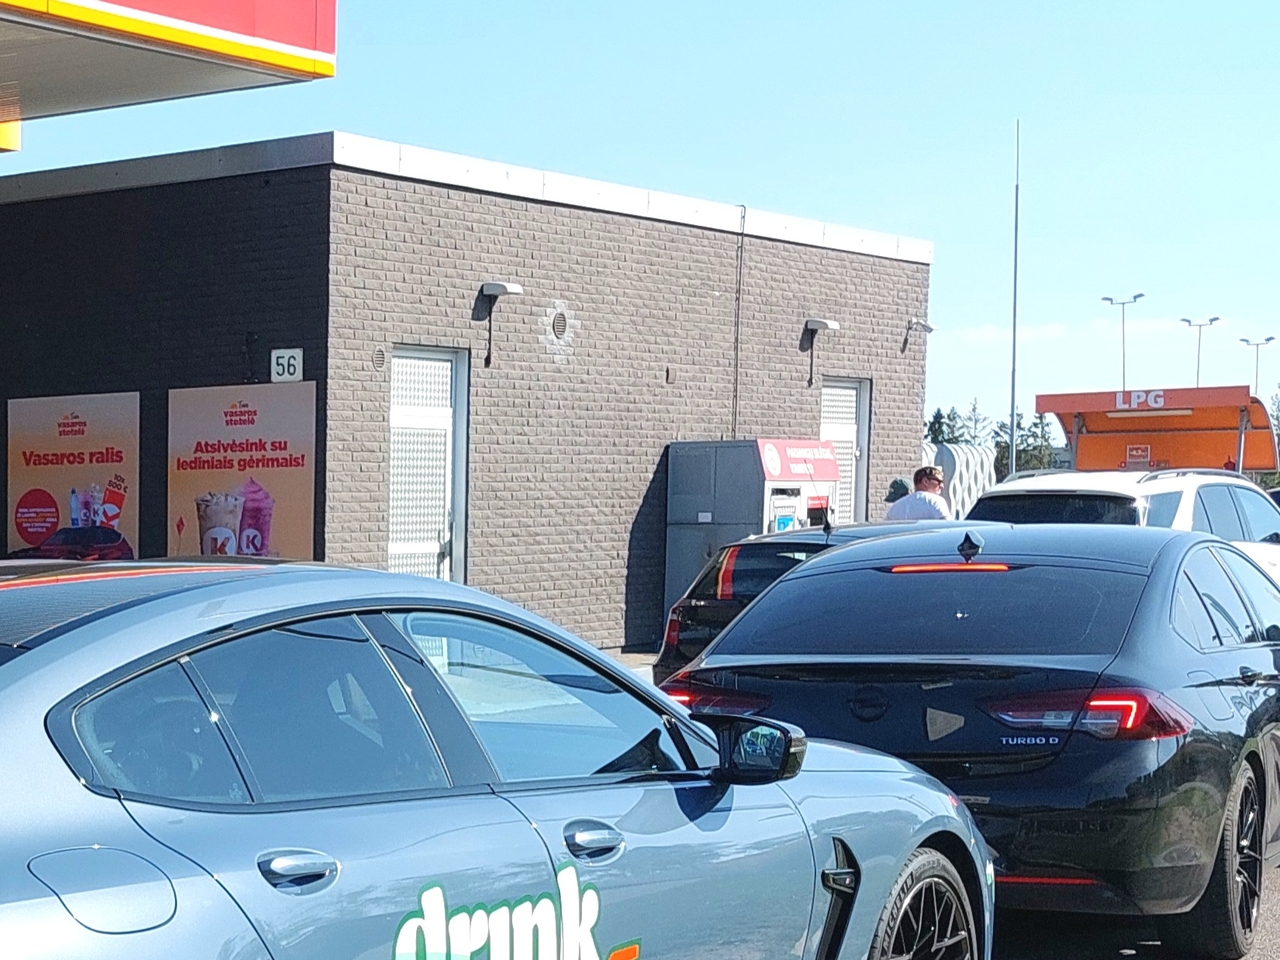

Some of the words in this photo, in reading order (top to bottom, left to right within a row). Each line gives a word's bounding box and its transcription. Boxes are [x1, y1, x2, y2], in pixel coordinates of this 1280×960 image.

[276, 355, 297, 377] 56
[1116, 391, 1165, 409] LPG
[223, 409, 258, 418] vasaros
[225, 417, 256, 426] stotelė
[57, 420, 87, 428] vasaros
[193, 438, 268, 454] Atsivėsink
[270, 441, 288, 452] su
[22, 450, 85, 466] Vasaros
[88, 447, 124, 464] ralis
[176, 456, 235, 471] lediniais
[237, 454, 306, 471] gėrimais!
[107, 480, 122, 491] 500
[245, 535, 261, 552] K
[1000, 737, 1046, 745] TURBO
[883, 876, 912, 952] MICHELIN
